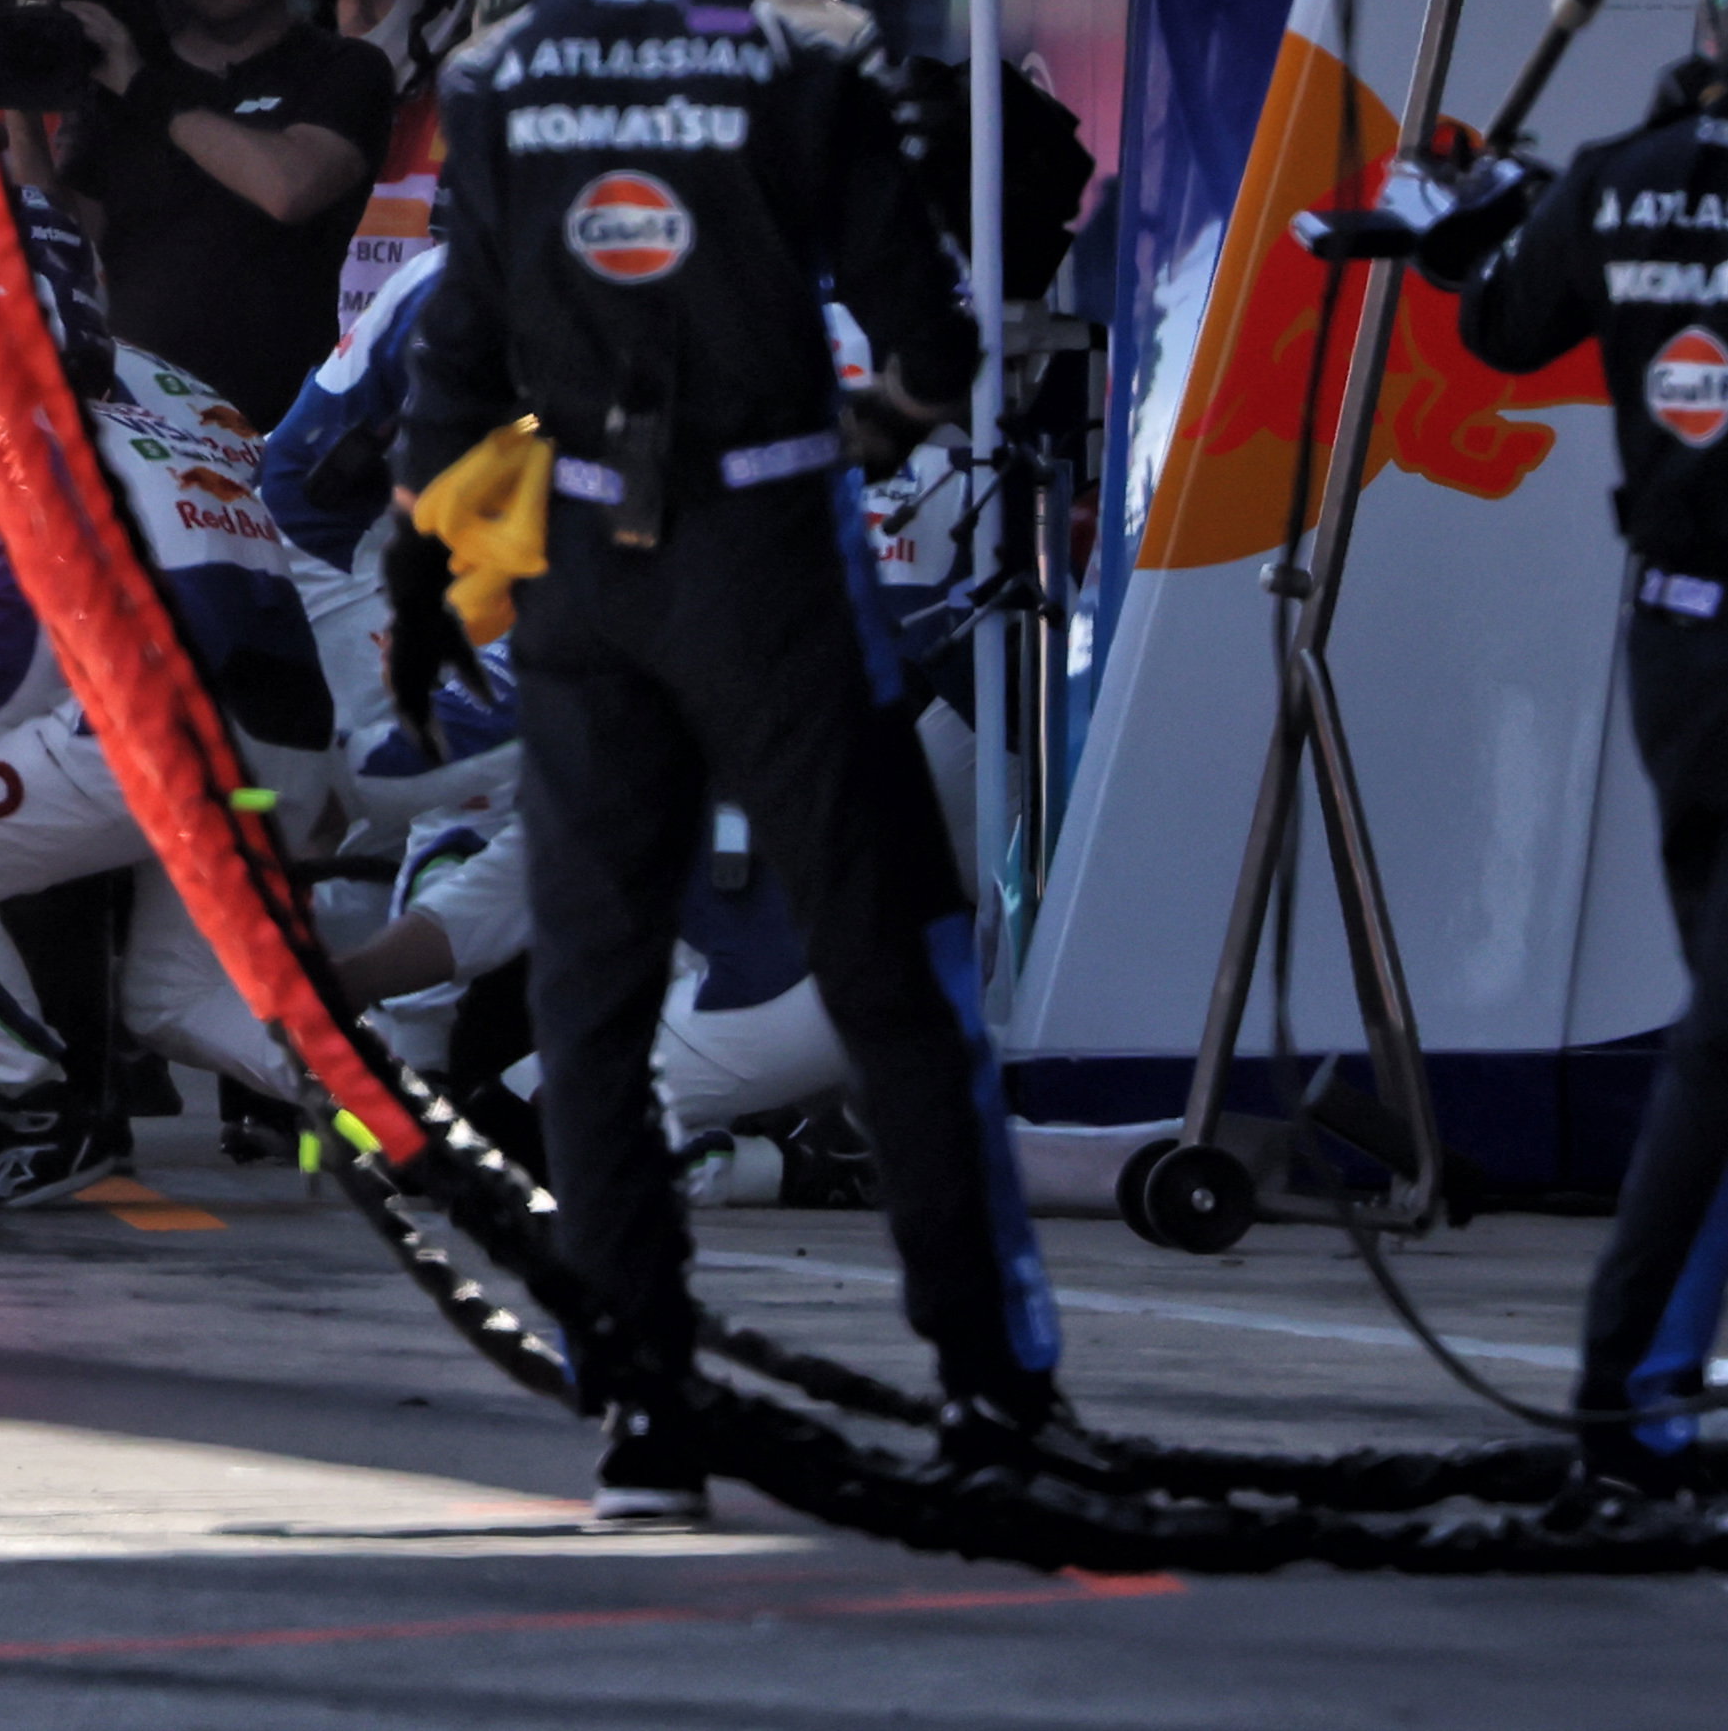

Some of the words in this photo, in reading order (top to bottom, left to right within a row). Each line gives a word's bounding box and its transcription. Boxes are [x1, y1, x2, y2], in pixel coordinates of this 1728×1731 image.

[530, 36, 773, 83] ATLASSIAN
[506, 93, 749, 153] KOMATSU
[1625, 188, 1728, 230] ATLA
[356, 240, 404, 263] BCN
[175, 500, 237, 535] Red
[234, 509, 283, 545] Bu
[878, 537, 916, 563] ull
